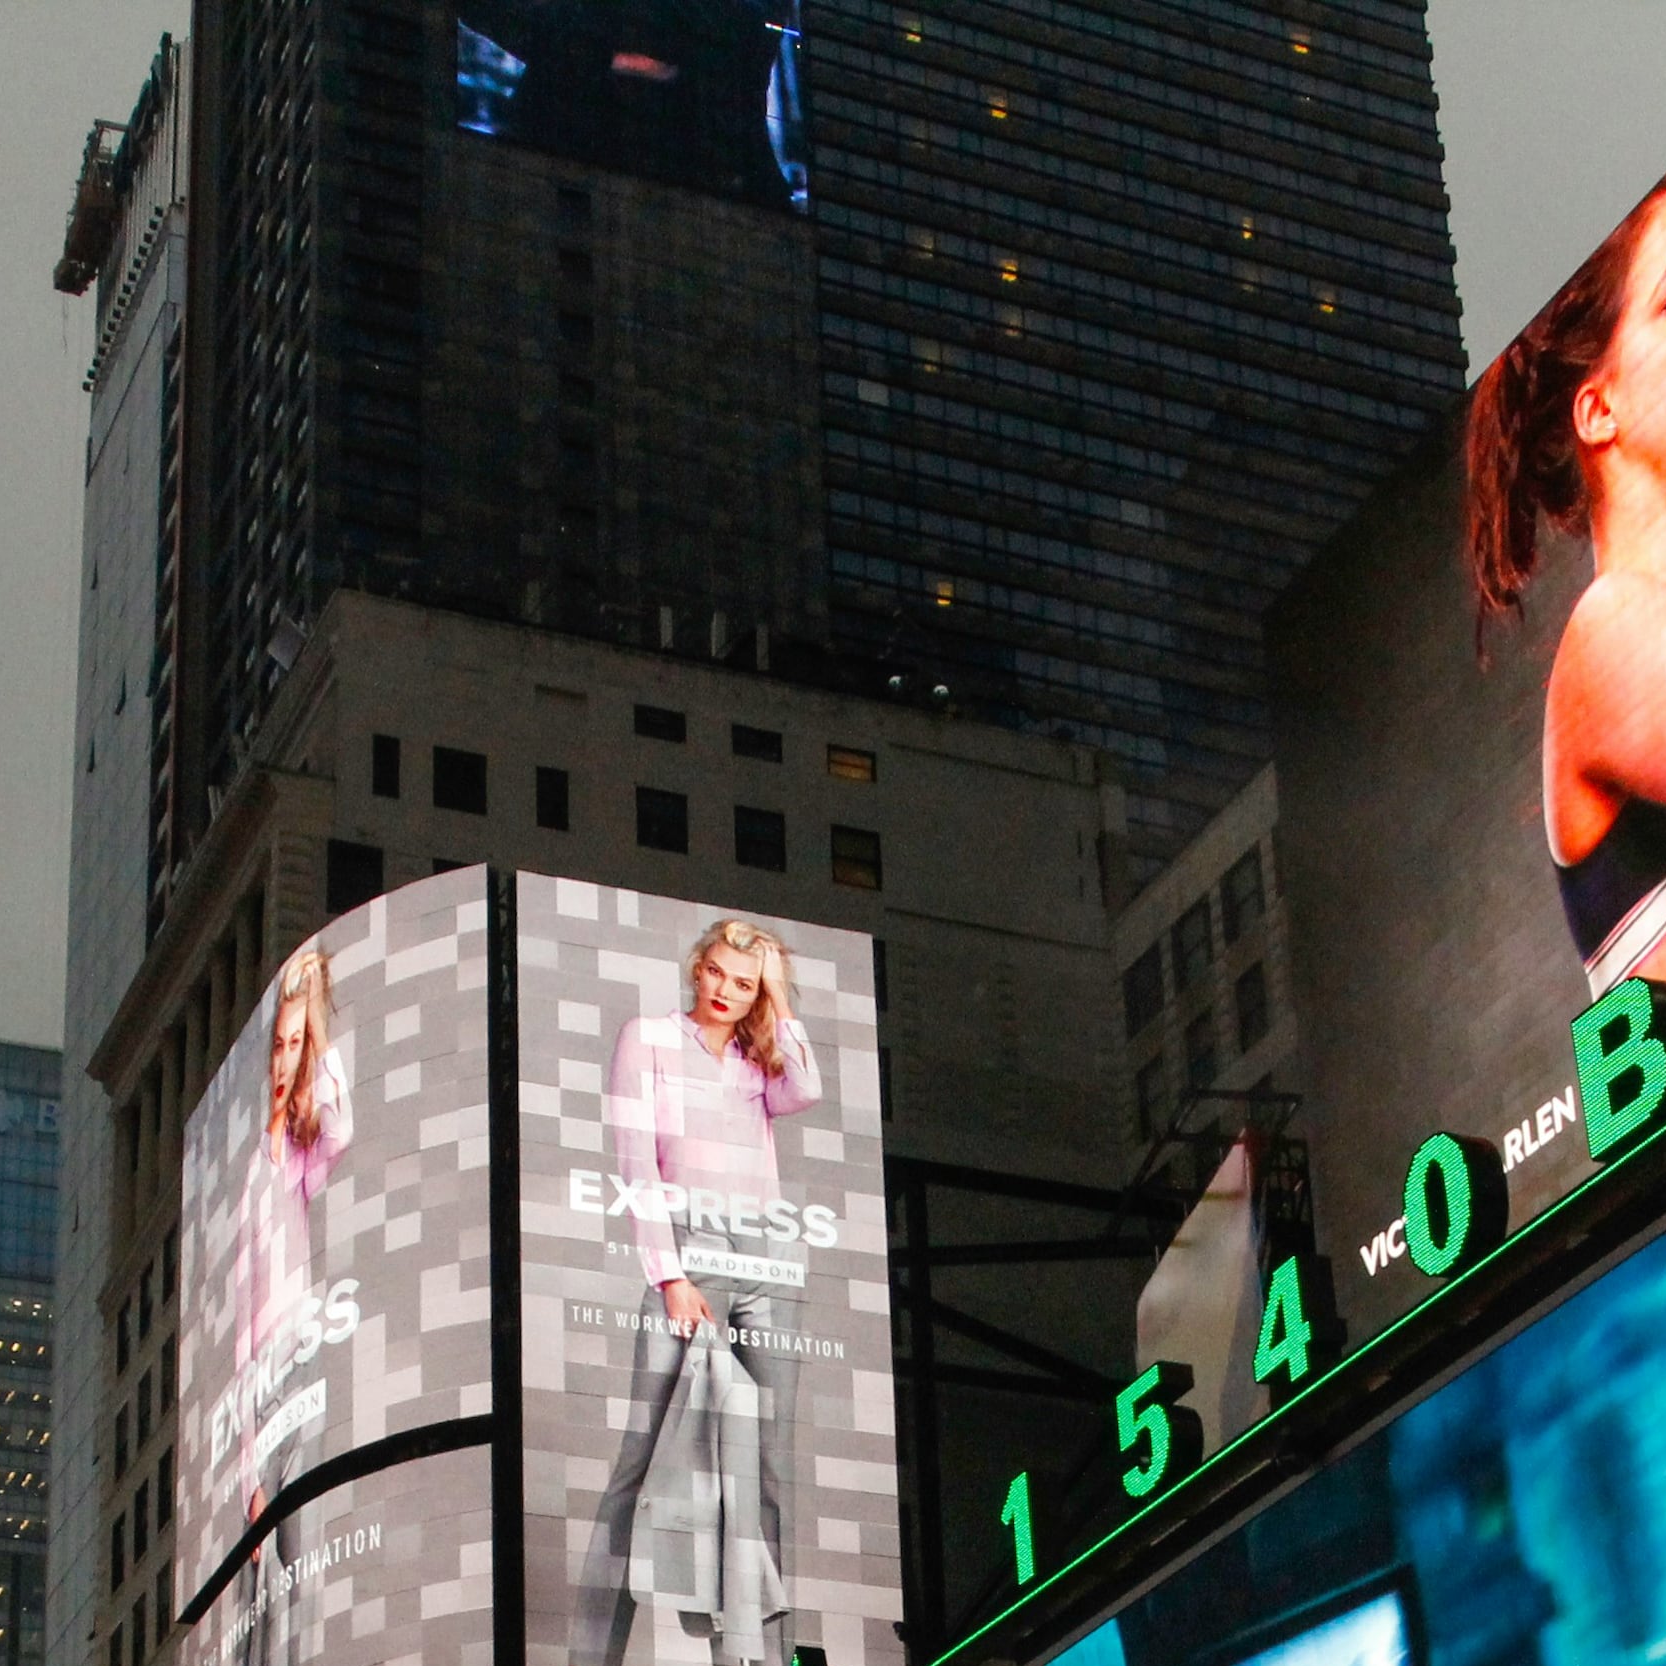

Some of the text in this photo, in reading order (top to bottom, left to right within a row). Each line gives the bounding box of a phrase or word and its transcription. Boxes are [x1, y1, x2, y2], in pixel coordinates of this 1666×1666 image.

[1500, 1084, 1576, 1173] RLEN
[569, 1168, 838, 1249] EXPRESS
[688, 1253, 799, 1281] MADISON
[572, 1305, 845, 1359] THE WORKWEAR DESTINATION
[210, 1278, 360, 1471] EXPRESS
[270, 1523, 382, 1604] DESTINATION
